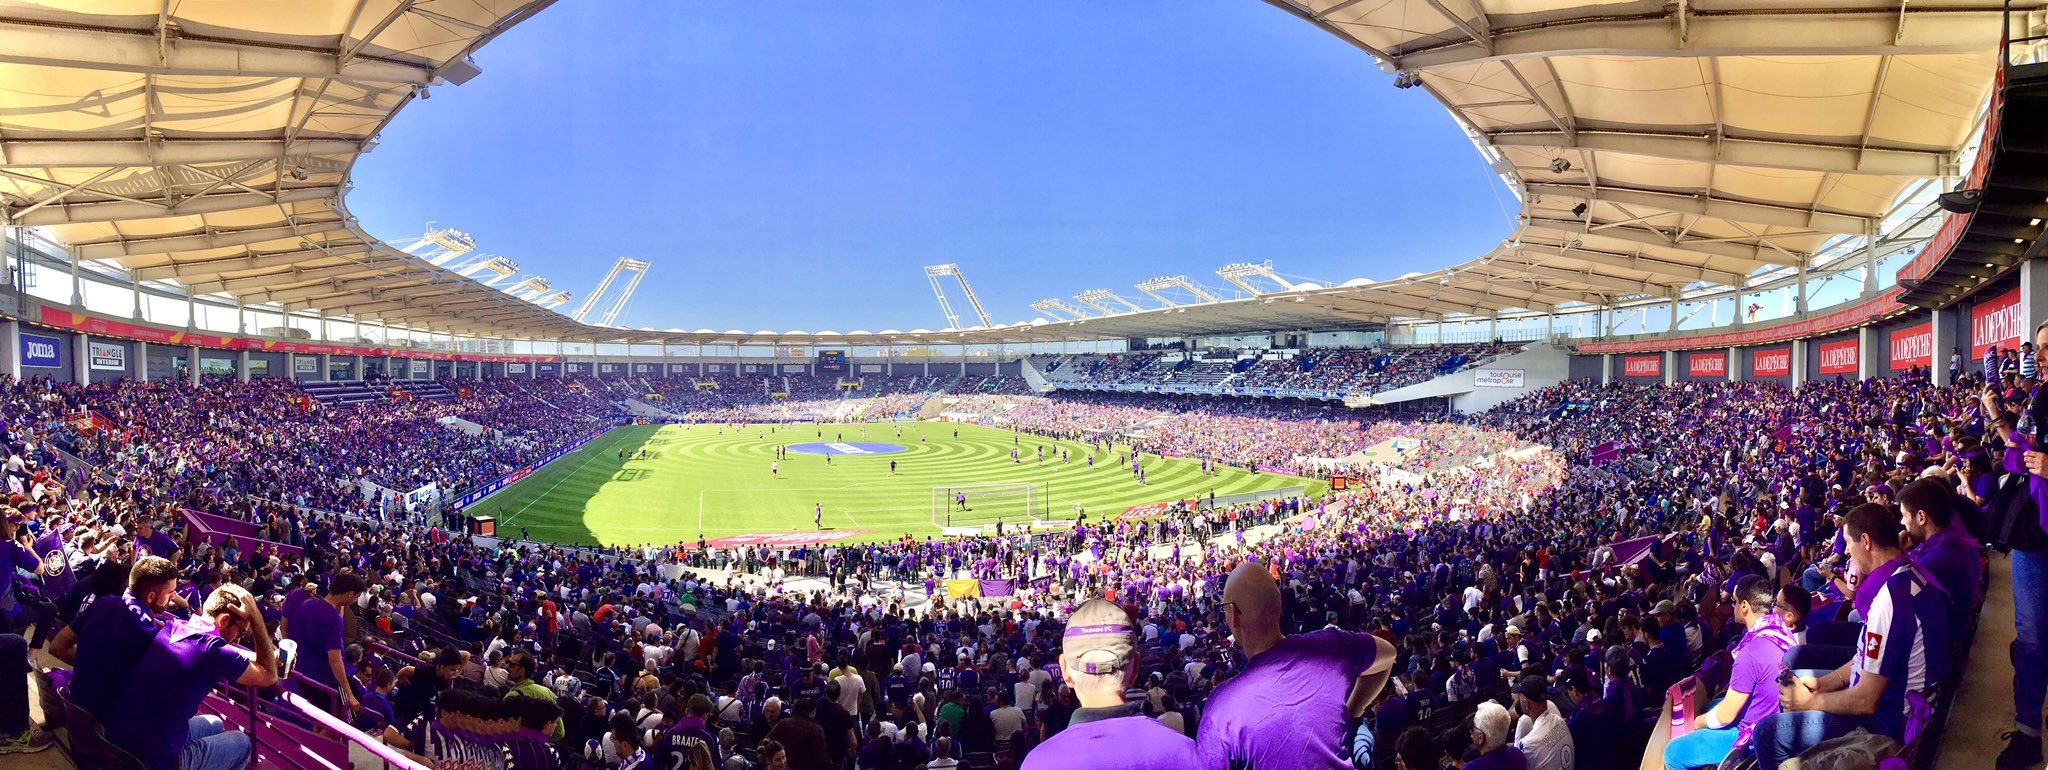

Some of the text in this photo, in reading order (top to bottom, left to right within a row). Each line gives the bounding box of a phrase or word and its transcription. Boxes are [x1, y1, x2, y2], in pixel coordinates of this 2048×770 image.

[1973, 316, 1985, 346] LA
[1892, 332, 1931, 360] LA DÉPÊCHE
[1755, 354, 1789, 370] LA DÉPÊCHE
[1821, 346, 1856, 367] LA DÉPÊCHE
[1626, 359, 1659, 371] LA DÉPÊCHE
[1691, 357, 1723, 371] LA DÉPÊCHE
[1490, 371, 1521, 379] toulouse
[1051, 668, 1060, 677] 10
[940, 679, 952, 690] 10
